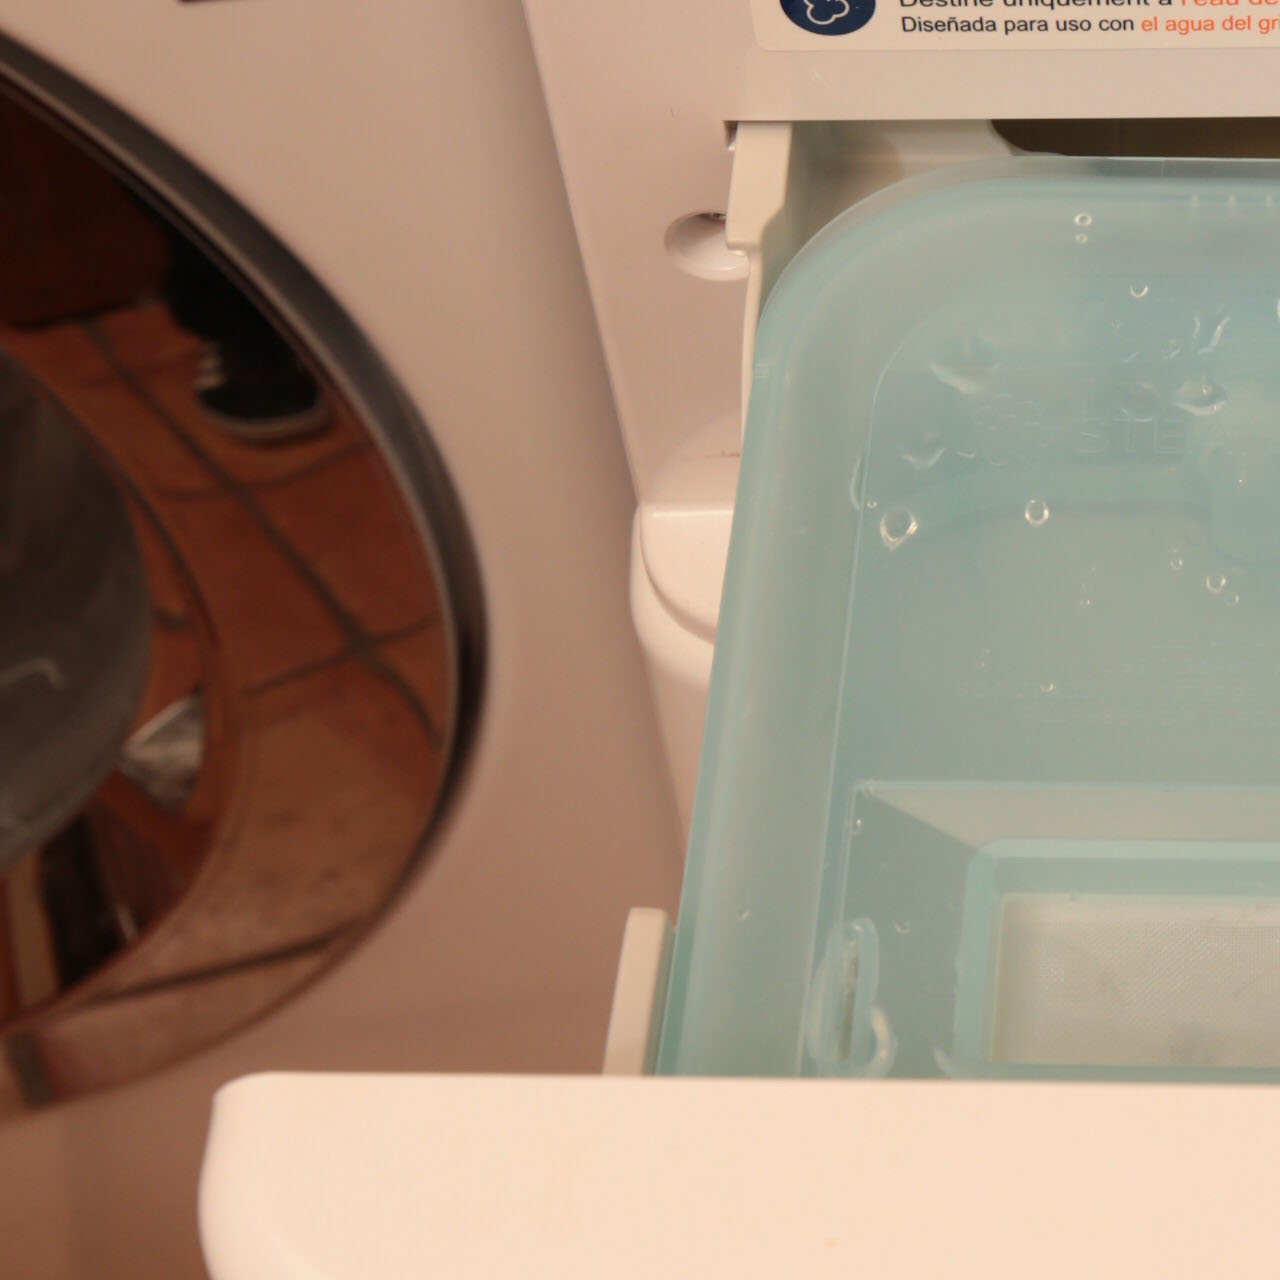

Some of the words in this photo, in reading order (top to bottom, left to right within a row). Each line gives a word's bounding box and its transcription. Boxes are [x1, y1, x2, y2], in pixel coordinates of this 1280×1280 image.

[902, 16, 996, 32] Diseñada
[1004, 20, 1048, 35] para
[1056, 20, 1091, 31] uso
[1099, 19, 1134, 31] con
[1141, 16, 1158, 32] el
[1166, 19, 1214, 35] agua
[1222, 15, 1251, 30] del
